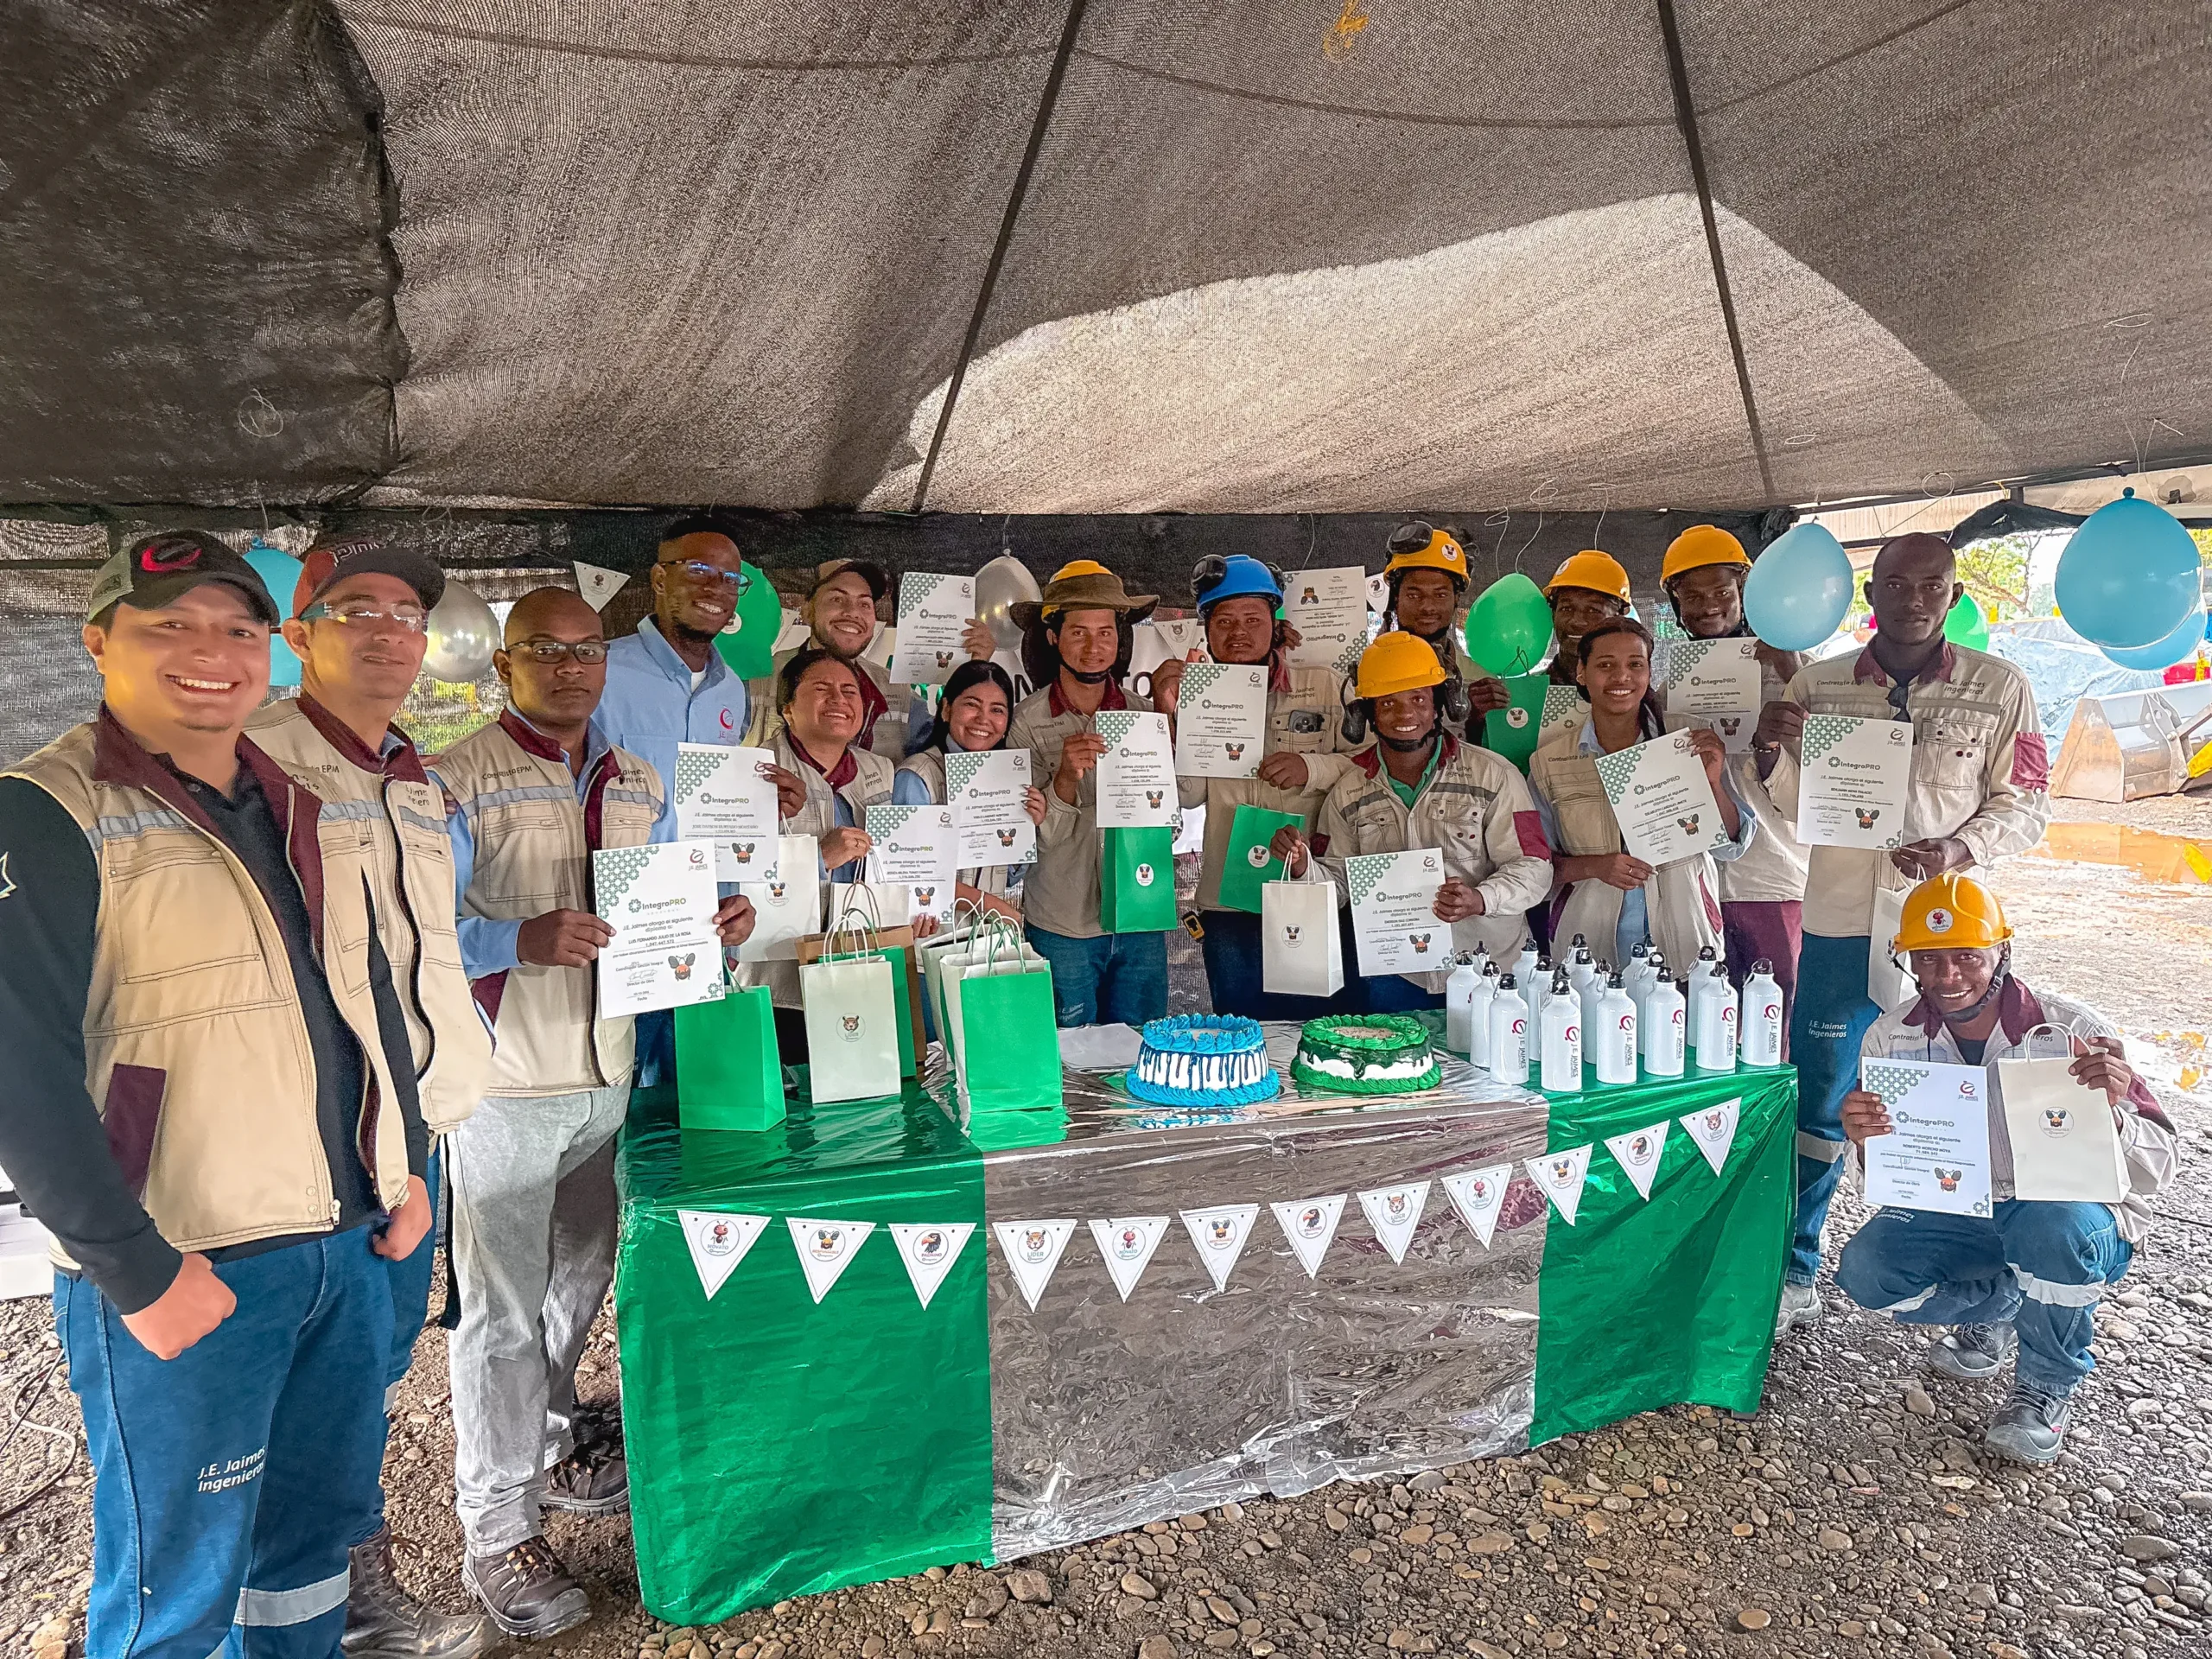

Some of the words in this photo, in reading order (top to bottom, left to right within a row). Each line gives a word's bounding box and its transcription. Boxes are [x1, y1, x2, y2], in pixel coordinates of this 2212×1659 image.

[1960, 679, 1986, 688] Jaimes
[1944, 686, 1984, 696] Ingenieros
[321, 765, 340, 773] EPM
[516, 765, 532, 773] EPM
[1840, 761, 1880, 770] IntegroPRO
[1645, 775, 1681, 791] IntegroPRO
[978, 789, 1010, 798] IntegroPRO
[642, 898, 686, 911] IntegroPRO
[671, 916, 693, 925] siguiente
[645, 925, 666, 933] diploma
[1808, 1020, 1820, 1028] J.E.
[1808, 1028, 1847, 1038] Ingenieros
[1910, 1117, 1955, 1128] IntegroPRO
[197, 1463, 220, 1479] J.E.
